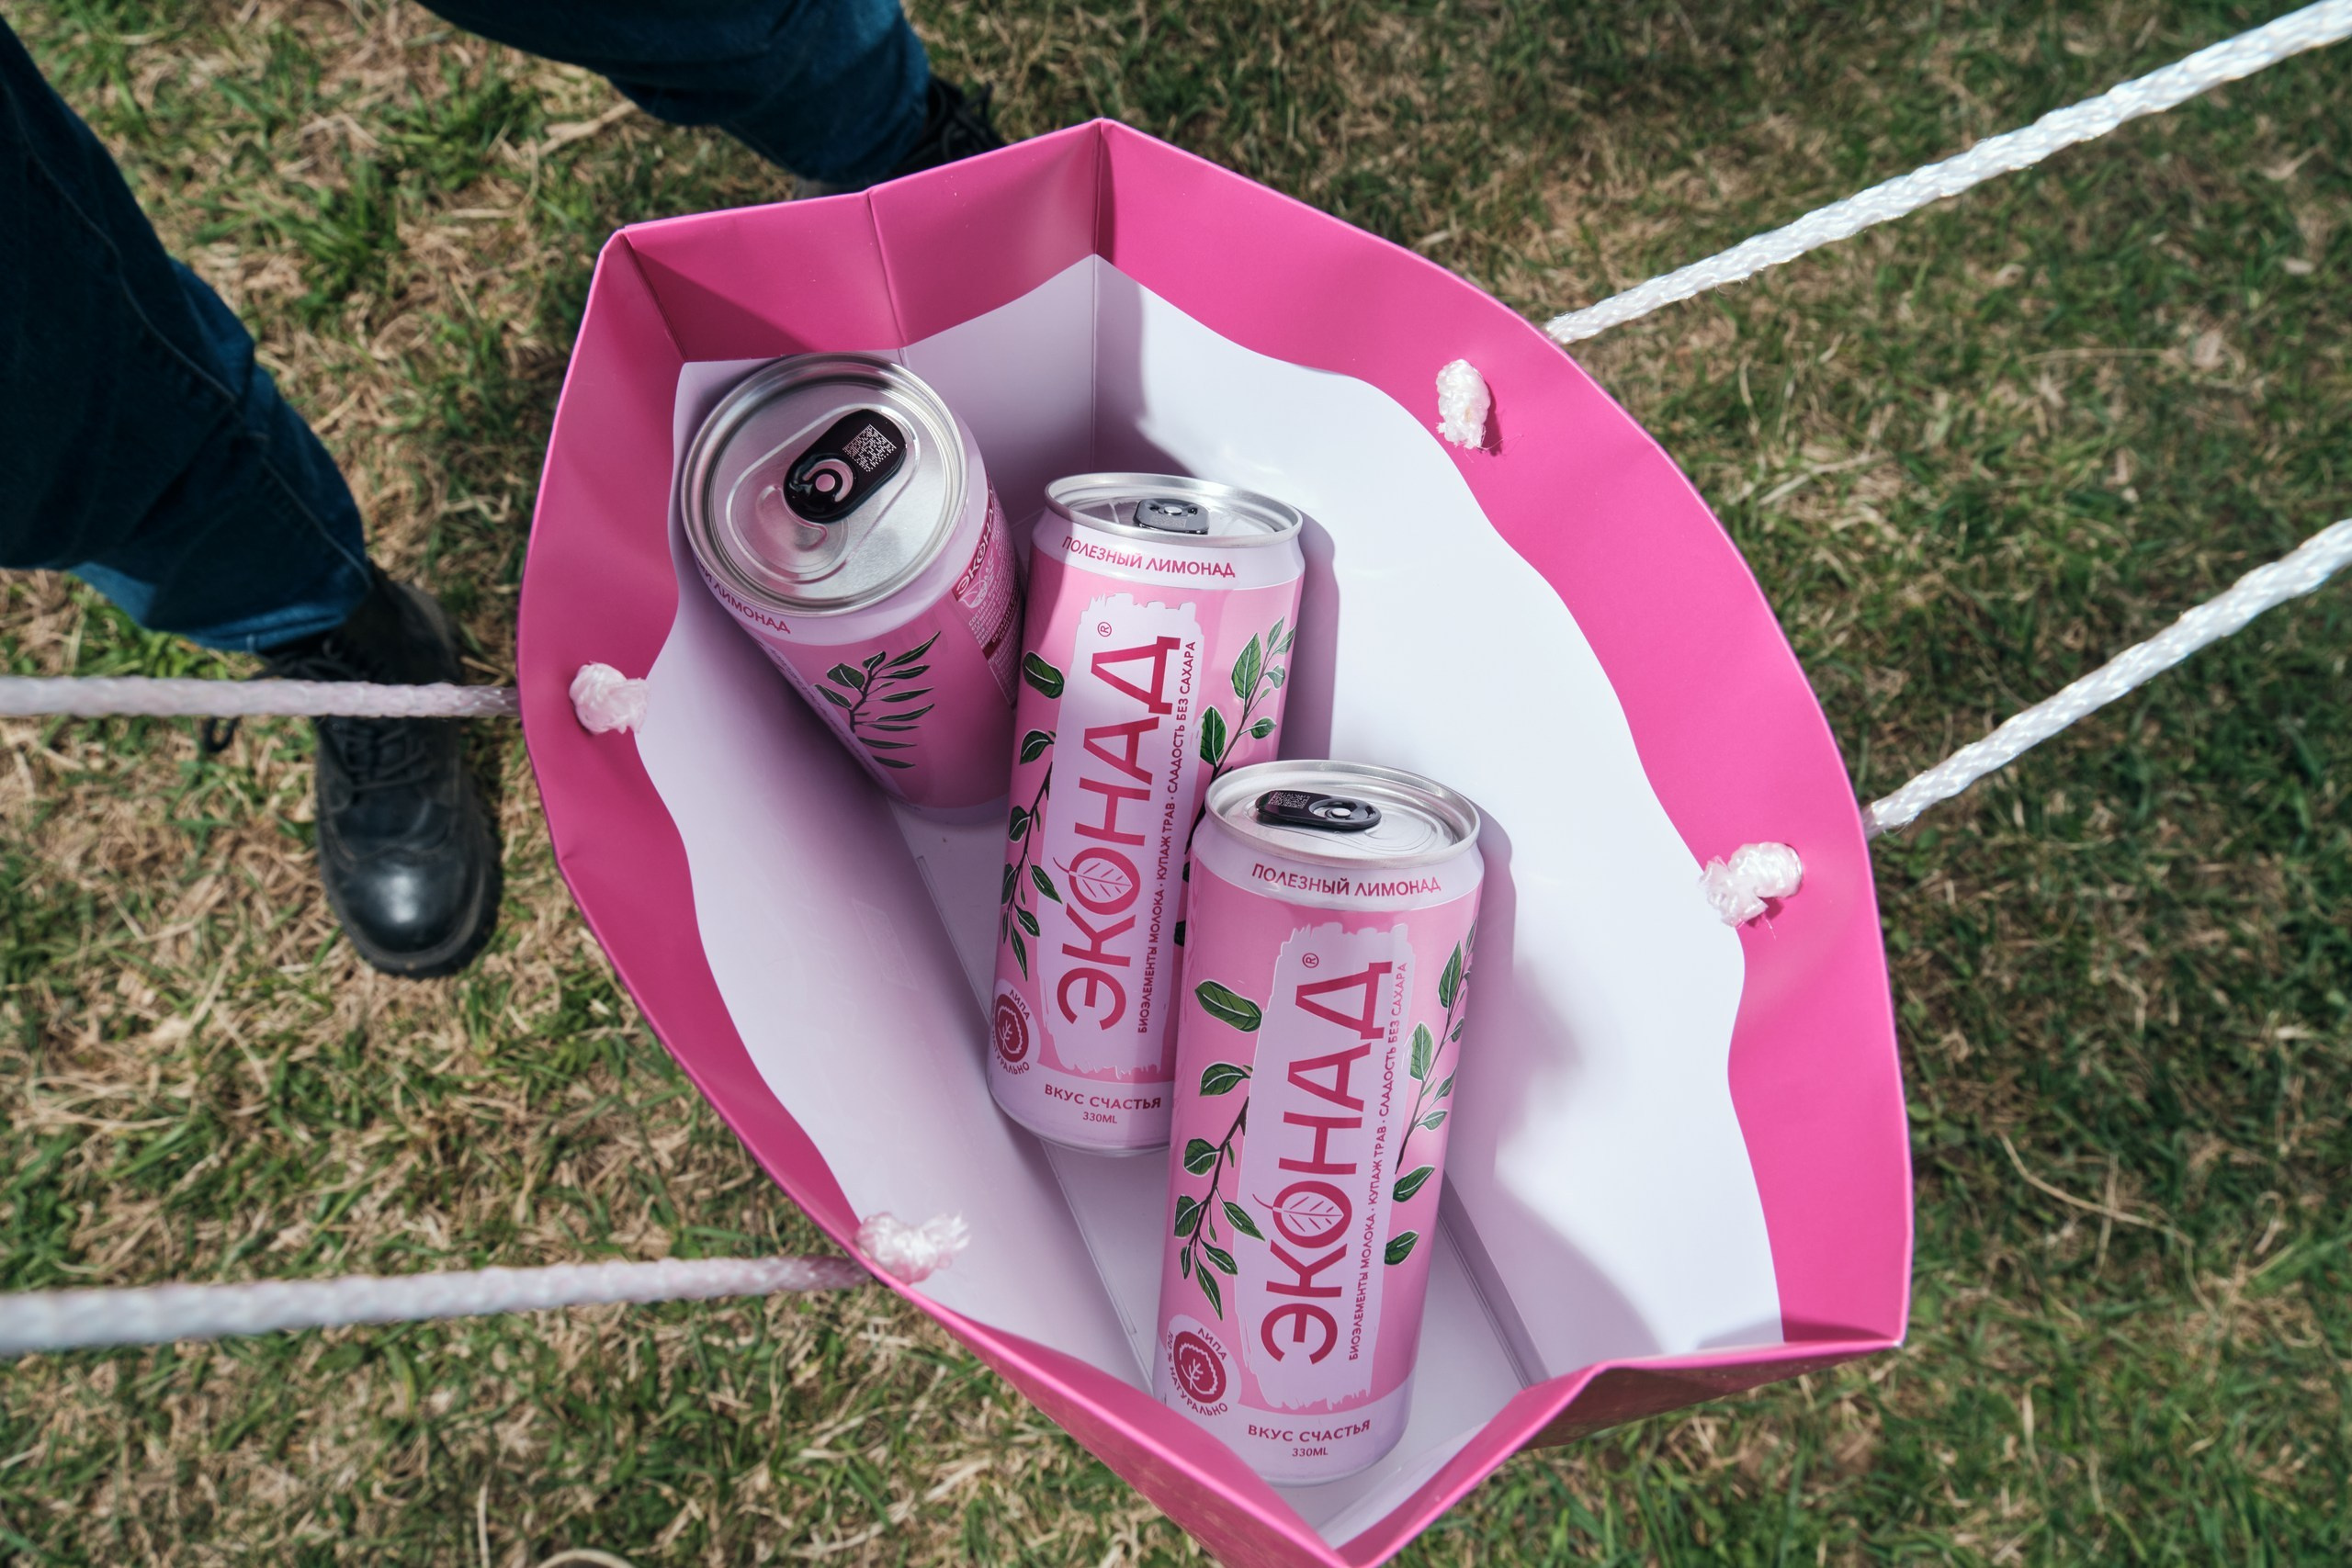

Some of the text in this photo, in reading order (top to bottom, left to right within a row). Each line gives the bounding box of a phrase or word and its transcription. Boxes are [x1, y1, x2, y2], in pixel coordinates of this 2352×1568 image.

[1061, 536, 1236, 579] ПОЛЕЗНЫЙ ЛИМОНАД
[714, 582, 791, 634] ЛИМОНАД
[1057, 636, 1182, 1031] ЭКОНАД
[1137, 641, 1196, 1034] БИОЭЛЕМЕНТЫ МОЛОКА КУПАЖ ТРАВ СЛАДОСТЬ БЕЗ САХАРА
[1251, 863, 1442, 897] ПОЛЕЗНЫЙ ЛИМОНАД
[1010, 989, 1030, 1021] ЛИПА
[1045, 1084, 1161, 1111] ВКУС СЧАСТЬЯ
[1082, 1111, 1117, 1124] 330ML
[1261, 961, 1393, 1365] ЭКОНАД
[1349, 963, 1408, 1361] БИОЭЛЕМЕНТЫ МОЛОКА КУПАЖ ТРАВ СЛАДОСТЬ БЕЗ САХАРА
[1197, 1327, 1227, 1360] ЛИПА
[1170, 1367, 1228, 1416] НАТУРАЛЬНО
[1248, 1419, 1371, 1443] ВКУС СЧАСТЬЯ
[1292, 1447, 1329, 1458] 330ML
